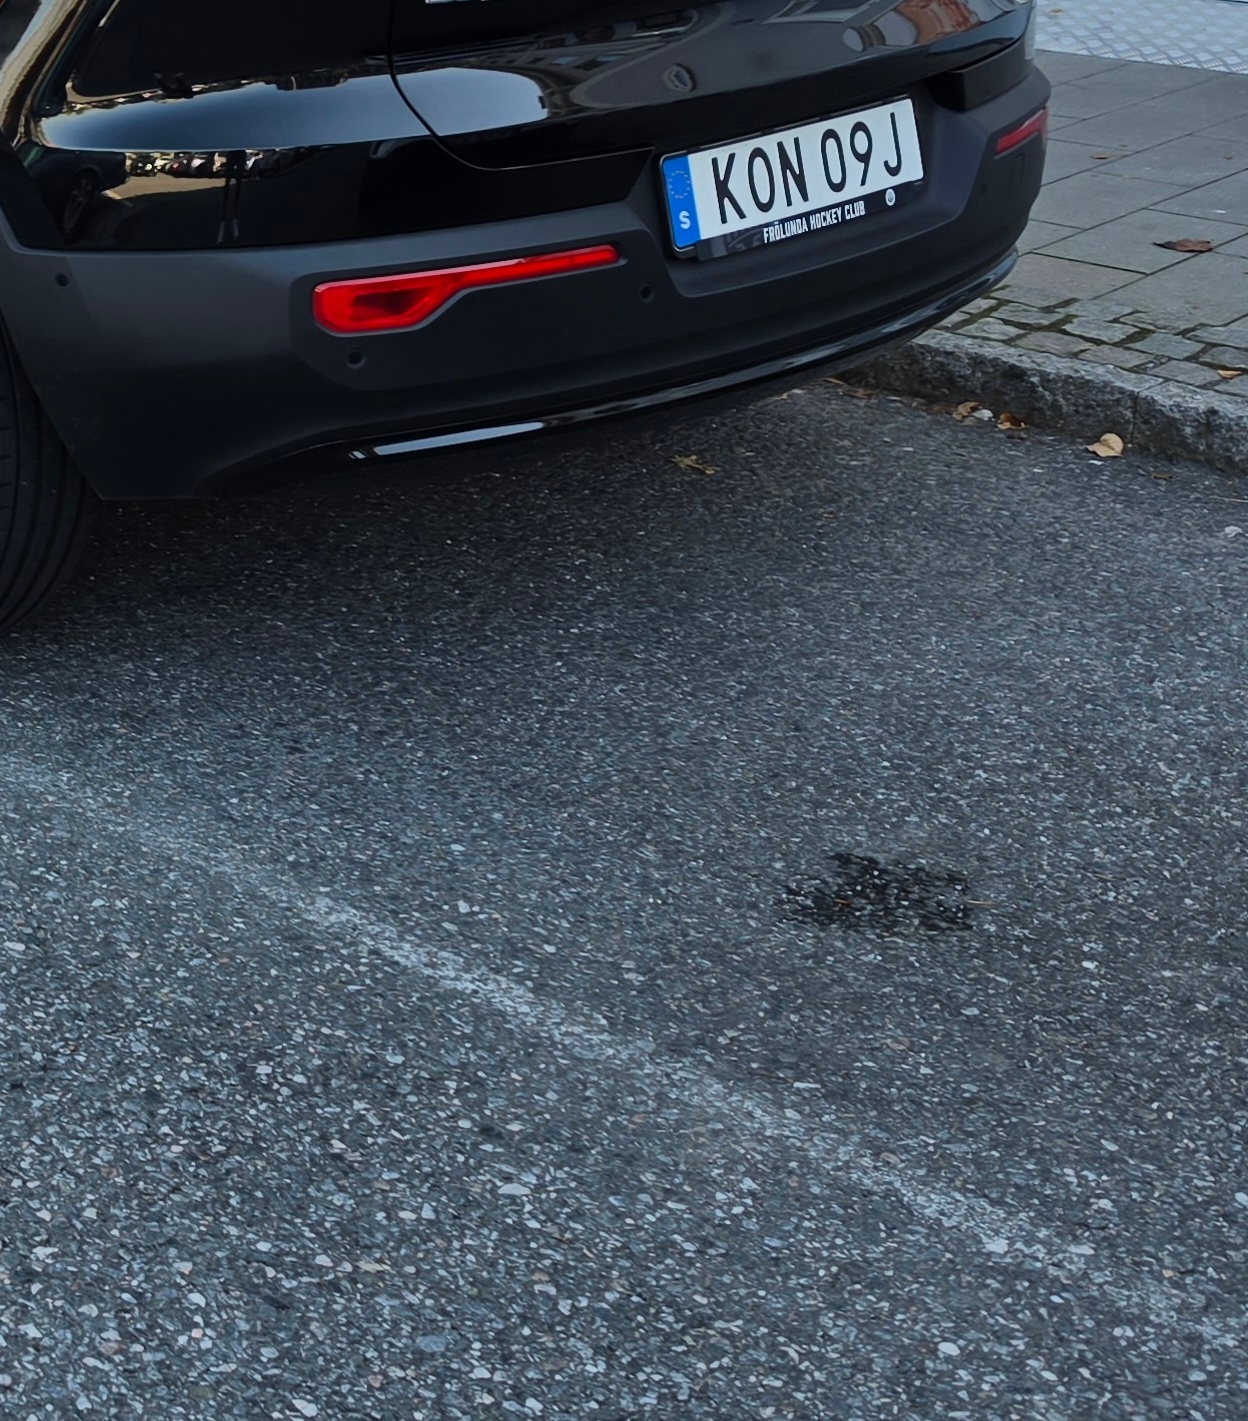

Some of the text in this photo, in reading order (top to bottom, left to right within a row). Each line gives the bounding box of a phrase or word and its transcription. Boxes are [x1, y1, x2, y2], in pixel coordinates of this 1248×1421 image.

[711, 111, 903, 224] KON 09J
[679, 210, 691, 229] S
[763, 200, 866, 244] FRÖLUNDA HOCKEY CLUB
